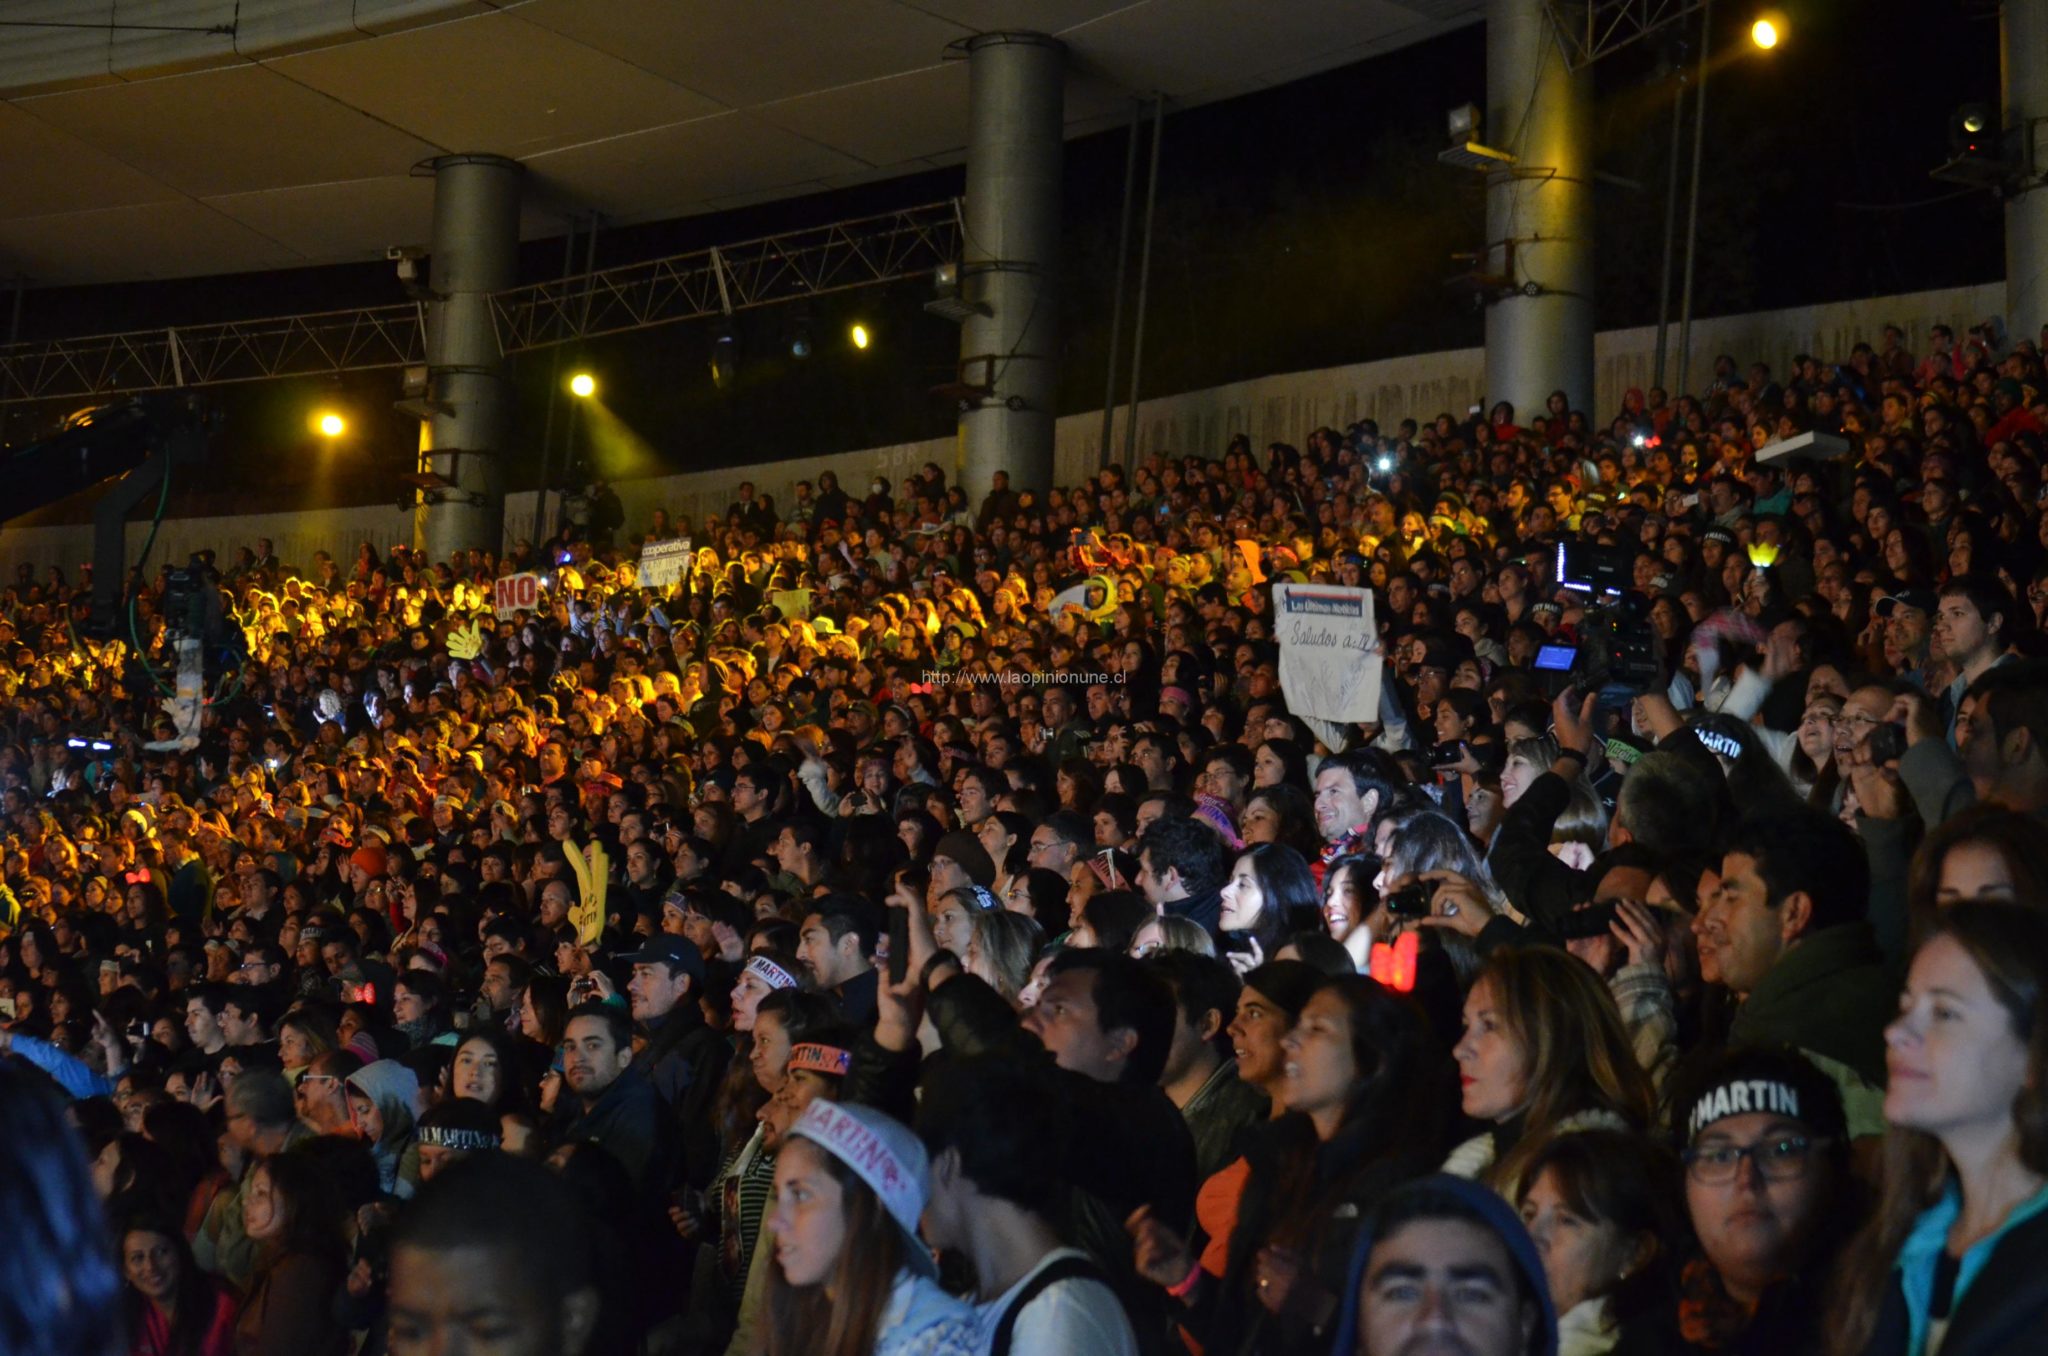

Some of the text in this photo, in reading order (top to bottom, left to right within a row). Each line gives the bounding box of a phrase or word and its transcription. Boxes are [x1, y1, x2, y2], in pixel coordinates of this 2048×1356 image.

[642, 539, 690, 557] cooperativa
[497, 576, 536, 609] NO
[1291, 620, 1337, 647] Saludos
[1697, 1080, 1799, 1131] MARTIN
